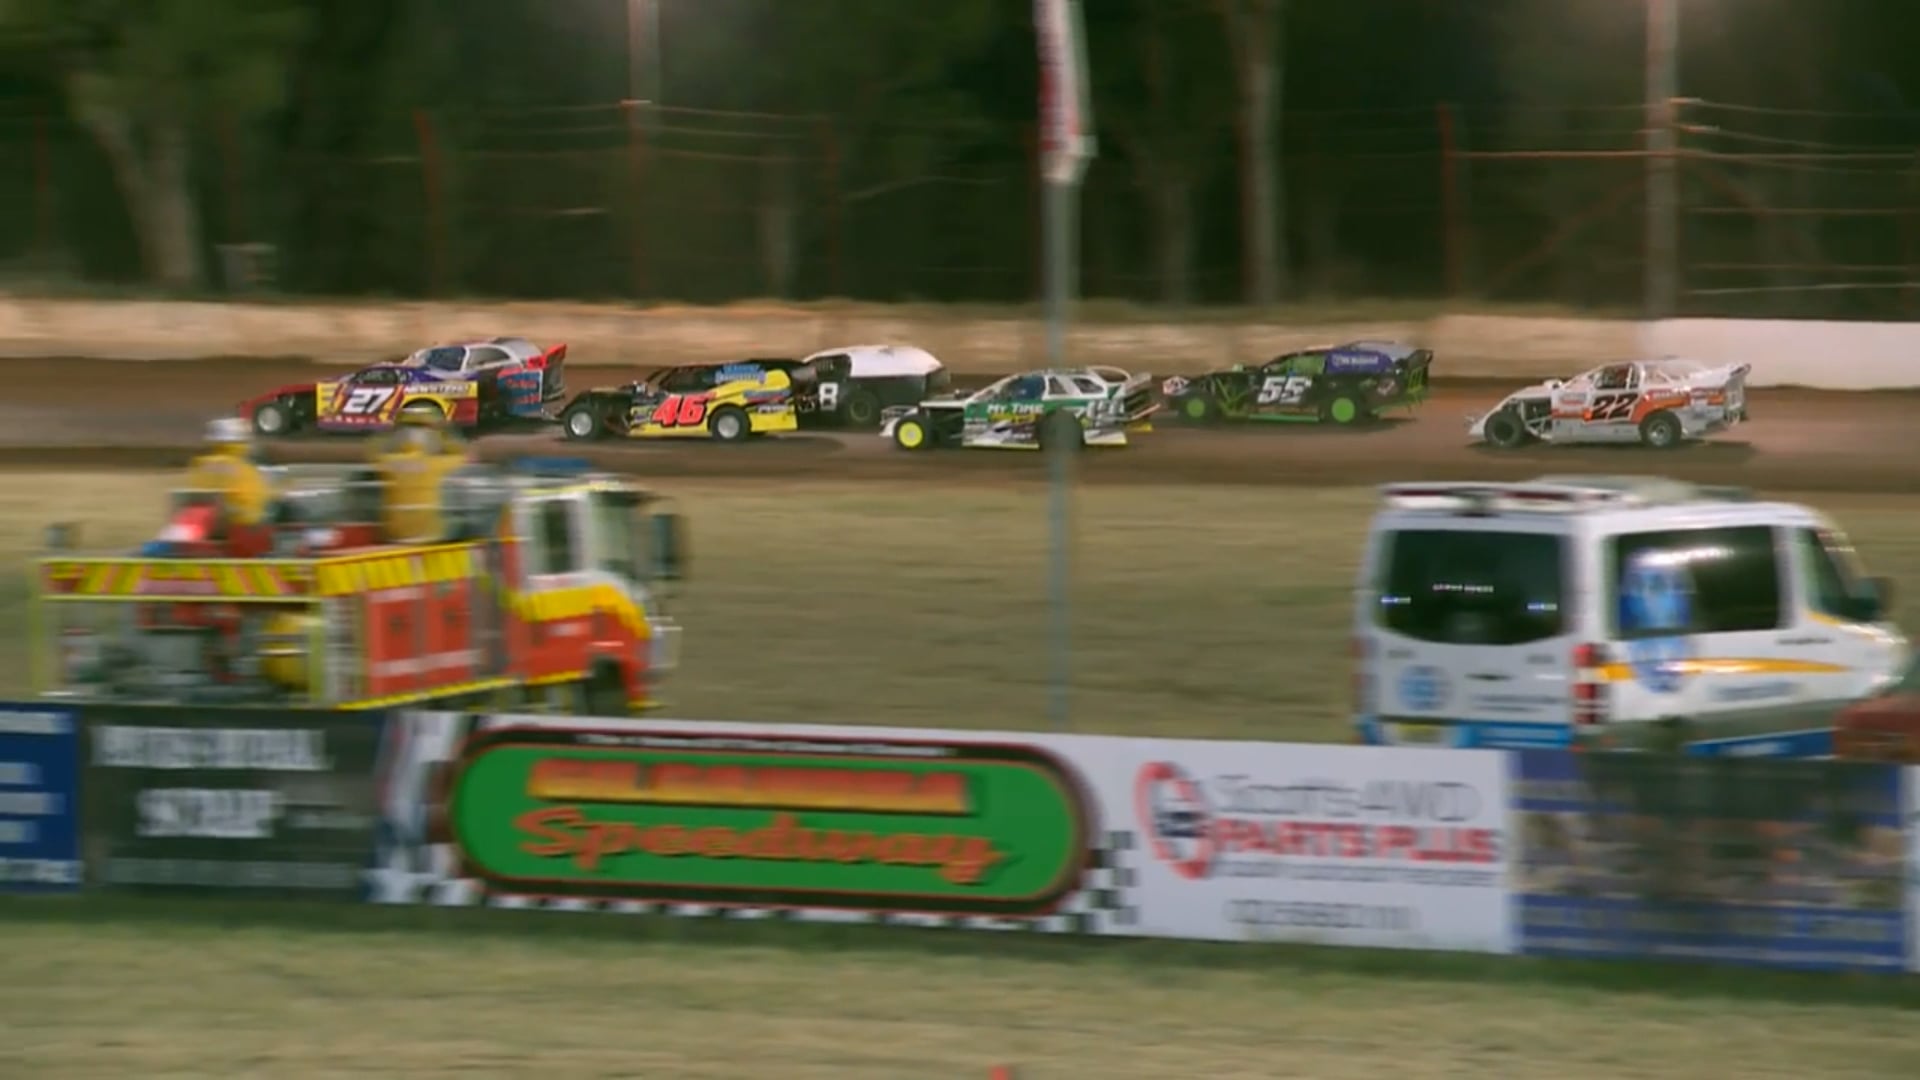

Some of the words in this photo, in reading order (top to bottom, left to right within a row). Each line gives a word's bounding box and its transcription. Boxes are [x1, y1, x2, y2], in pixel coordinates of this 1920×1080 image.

[343, 388, 395, 414] 27
[819, 382, 838, 410] 8
[1257, 376, 1307, 404] 55
[651, 393, 708, 427] 46
[1592, 393, 1639, 420] 22
[514, 806, 1004, 883] Speedway
[1215, 817, 1366, 858] PARTS
[1376, 824, 1496, 864] PLUS
